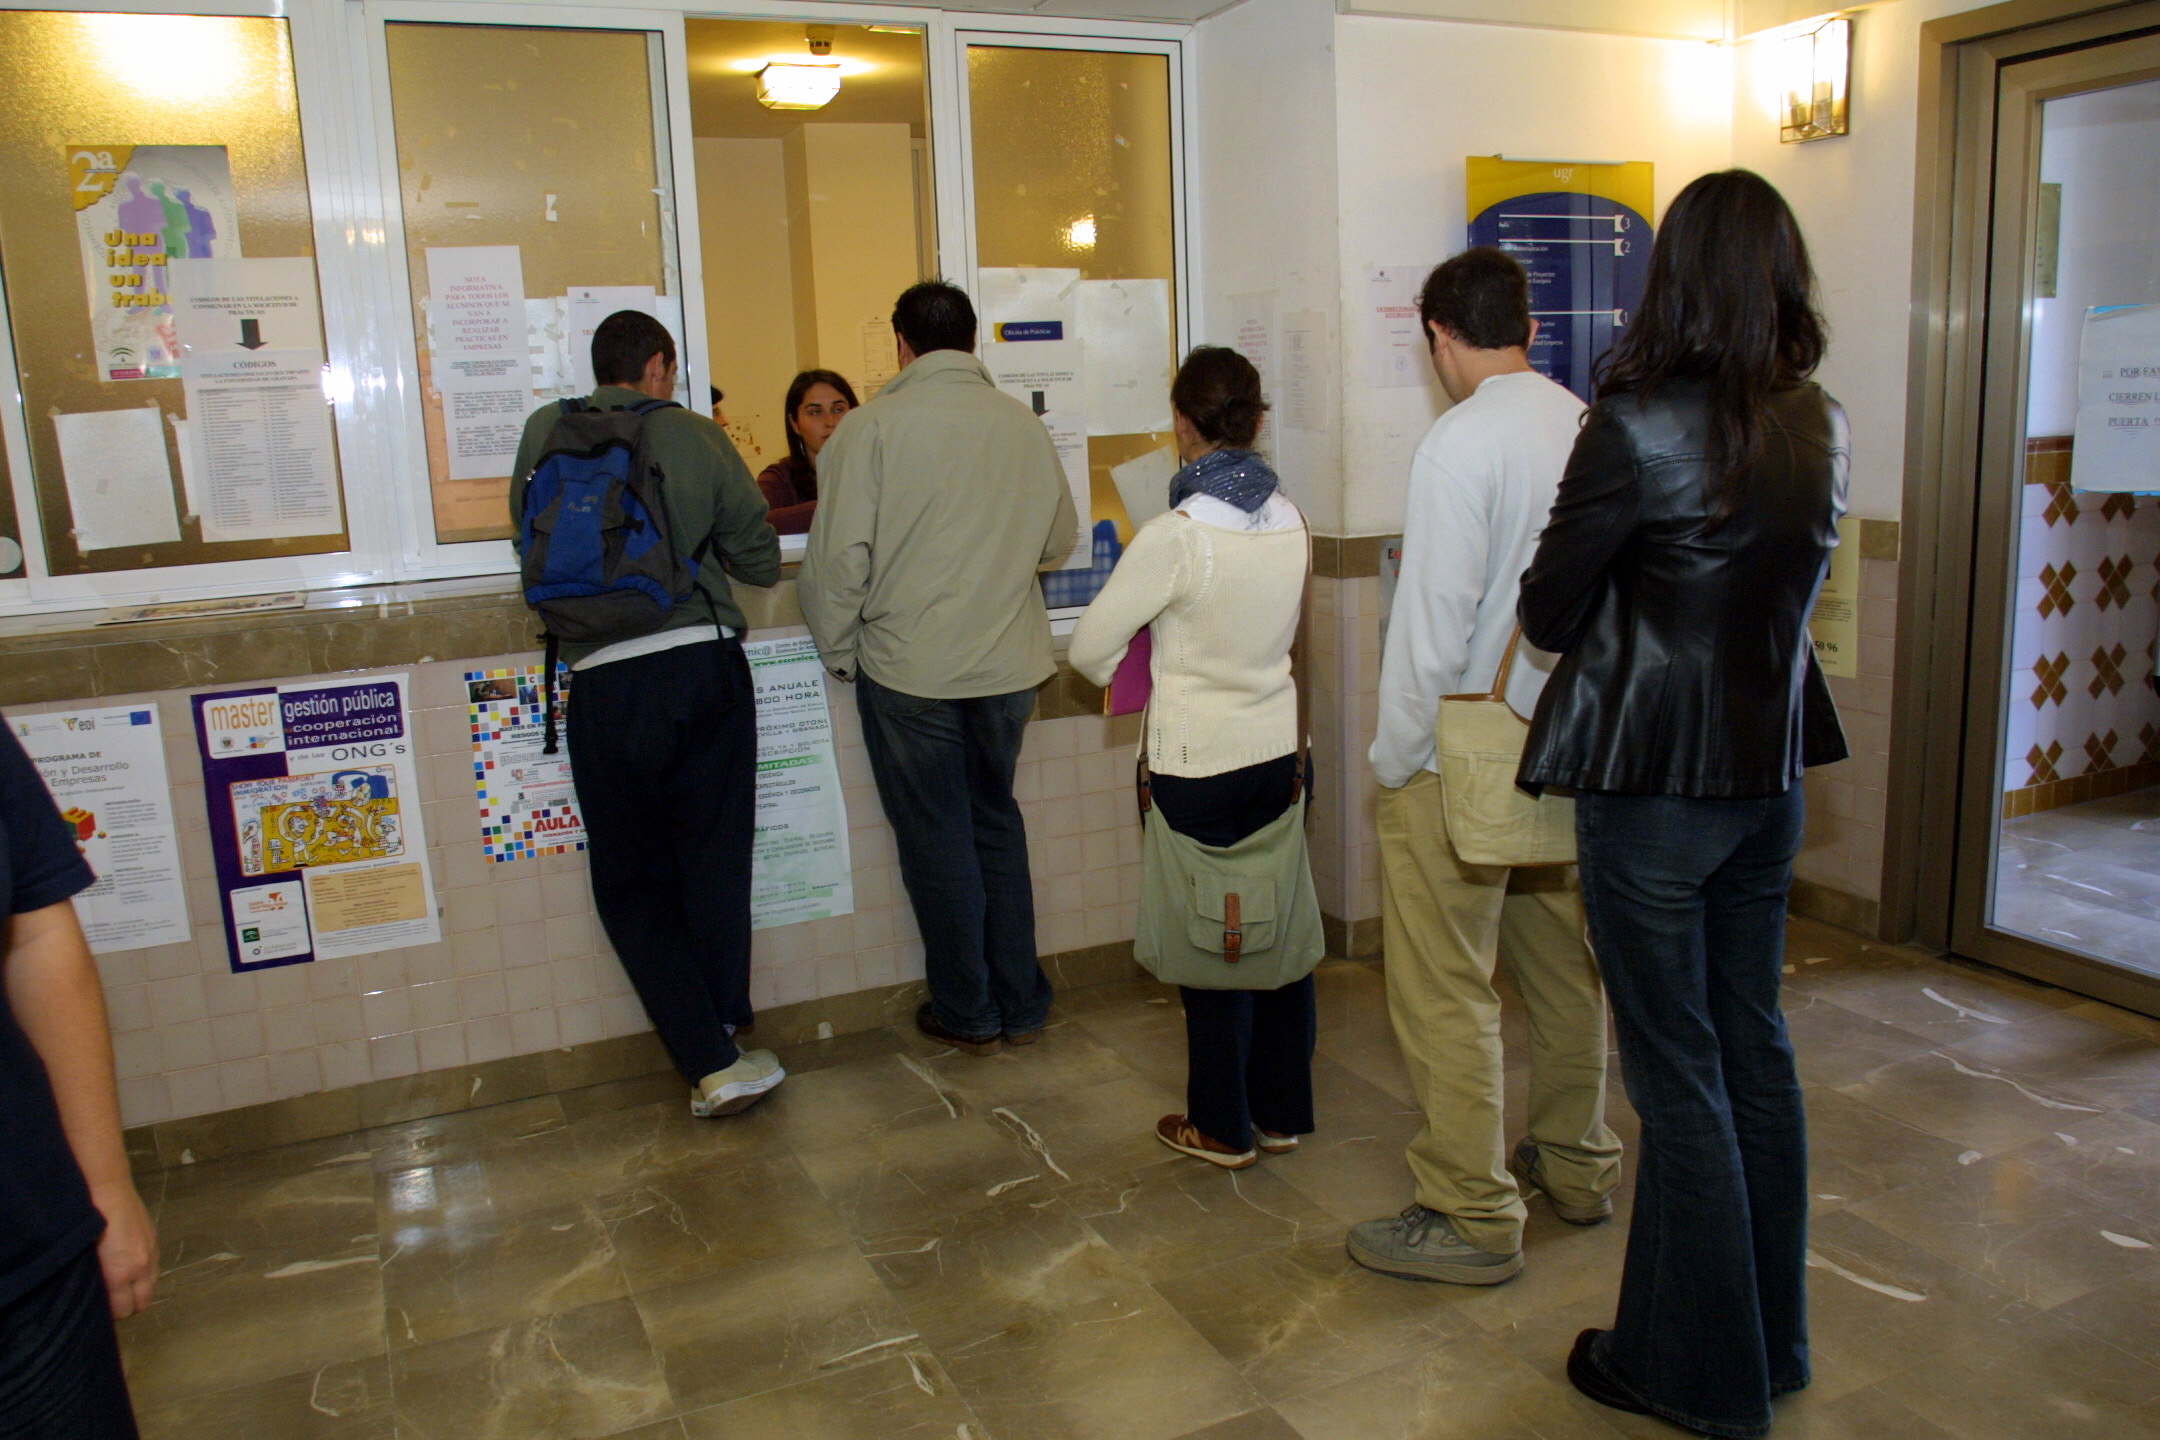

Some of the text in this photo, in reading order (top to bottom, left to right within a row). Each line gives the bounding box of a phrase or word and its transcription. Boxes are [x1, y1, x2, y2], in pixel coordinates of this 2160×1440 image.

[1553, 167, 1574, 184] ugr
[1624, 217, 1631, 230] 3
[104, 229, 158, 247] Una
[1624, 242, 1631, 254] 2
[106, 248, 168, 267] idea
[110, 273, 143, 287] un
[112, 288, 174, 309] trab
[2120, 367, 2140, 377] POR
[2108, 391, 2152, 401] CIERREN
[2108, 417, 2149, 427] PUERTA
[770, 680, 819, 692] ANUALE
[785, 691, 820, 701] HORA
[210, 688, 395, 731] master gestión pública
[292, 714, 397, 732] cooperación
[287, 724, 399, 746] internacional
[88, 751, 103, 759] DE
[72, 761, 130, 776] Desarrollo
[51, 774, 107, 788] Empresas
[534, 815, 581, 832] AULA
